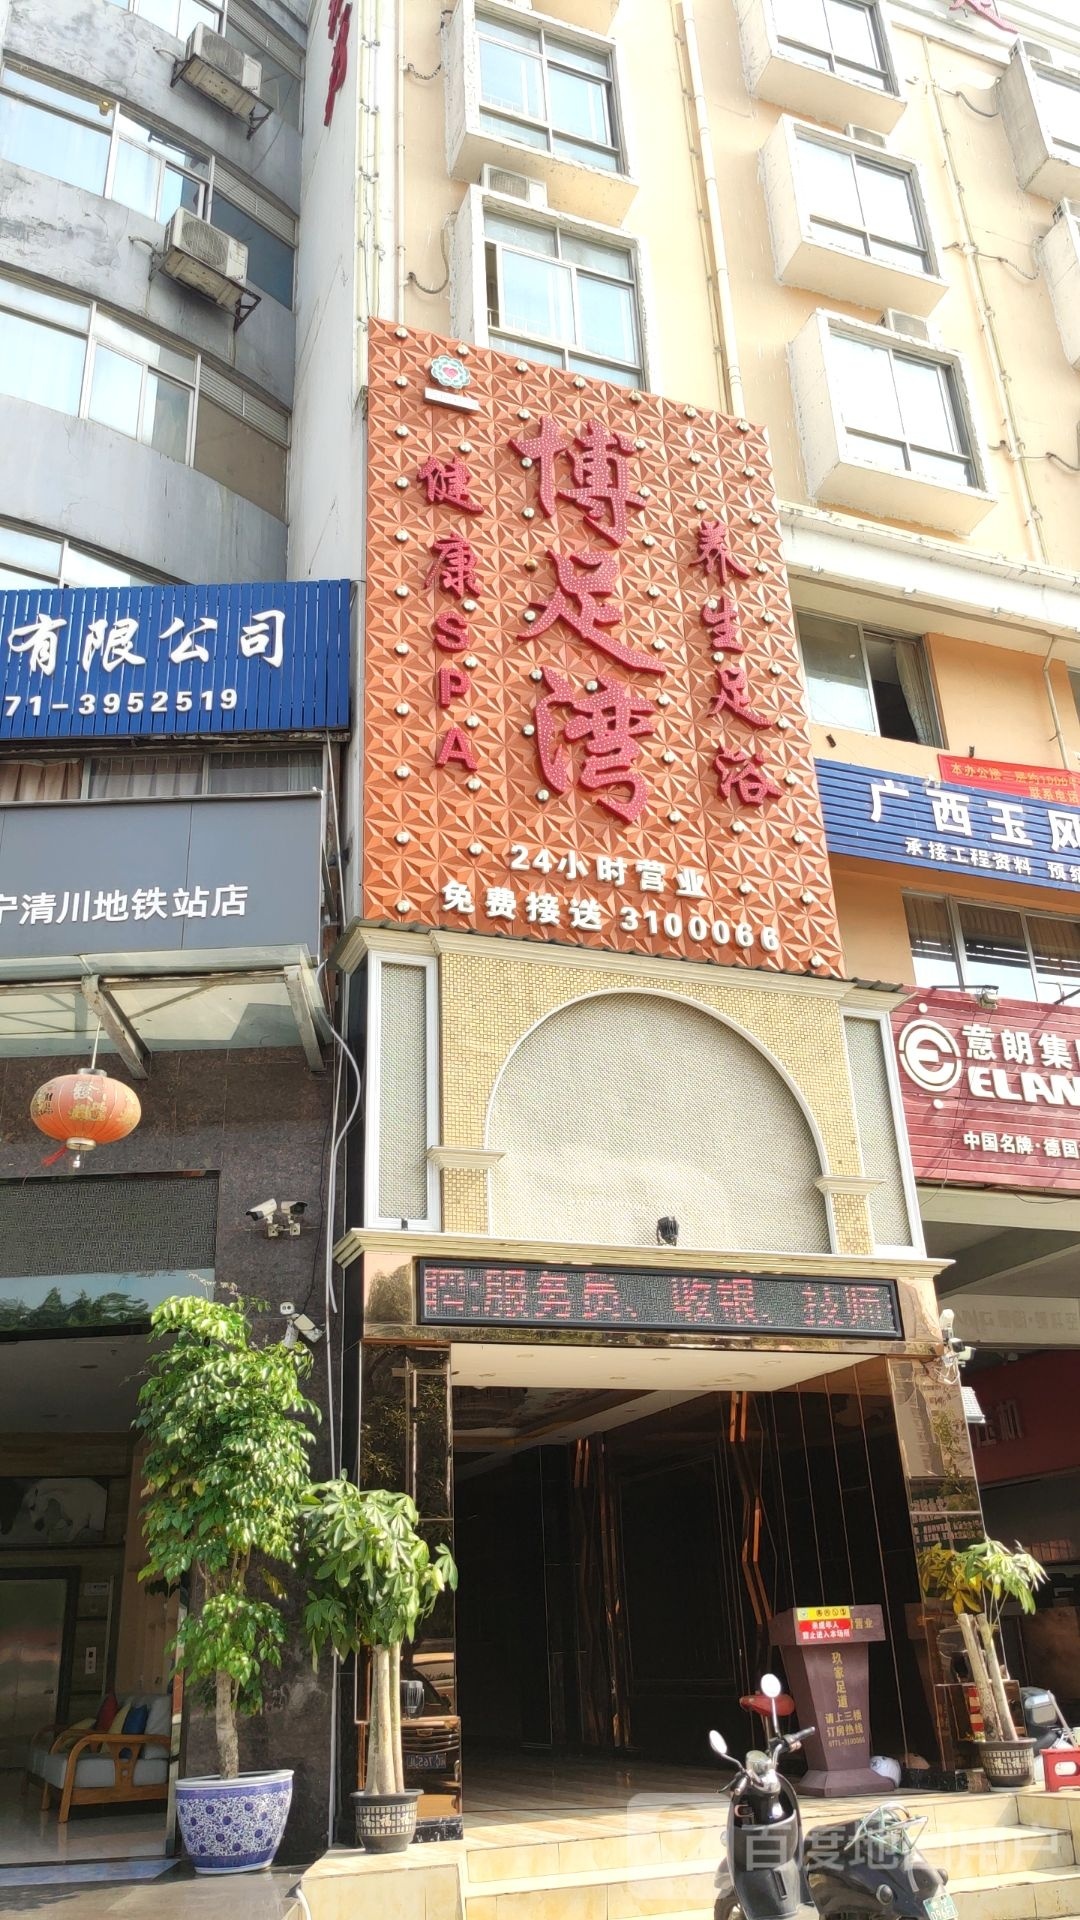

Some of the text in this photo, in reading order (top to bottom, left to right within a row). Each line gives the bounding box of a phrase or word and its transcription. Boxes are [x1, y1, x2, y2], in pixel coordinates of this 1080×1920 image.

[8, 609, 286, 677] 有限公司
[417, 456, 484, 772] 健康SPA
[689, 519, 783, 807] 养生足浴
[5, 688, 238, 717] 71-3952519
[510, 844, 708, 899] 24小时营业
[904, 836, 1031, 876] 承接工程资料
[442, 881, 782, 953] 免费接送 3100066
[962, 1023, 1080, 1070] 意朗集
